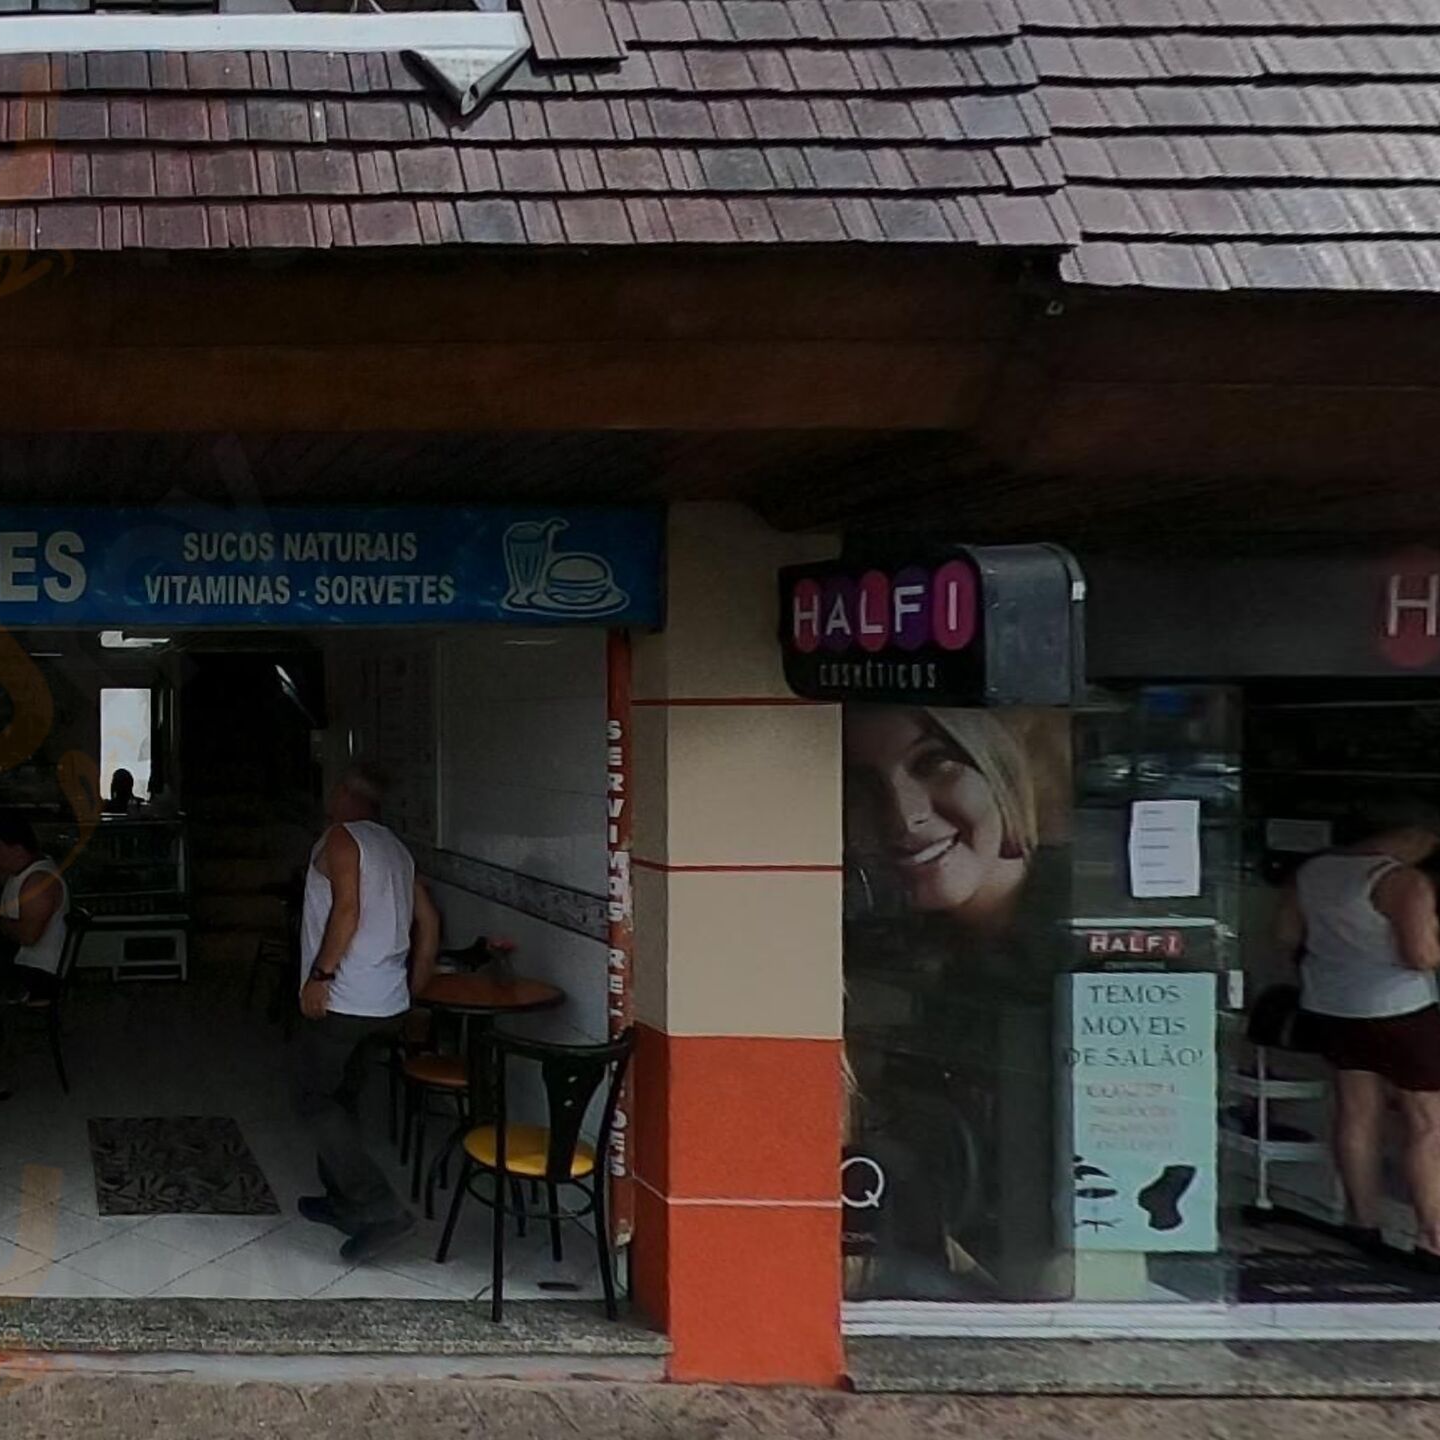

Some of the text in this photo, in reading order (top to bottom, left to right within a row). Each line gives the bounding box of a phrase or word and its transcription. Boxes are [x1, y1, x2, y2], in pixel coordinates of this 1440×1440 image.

[182, 533, 418, 562] SUCOS NATURAIS
[144, 574, 291, 606] VITAMINAS
[314, 574, 456, 606] SORVETES
[1087, 984, 1181, 1004] TEMOS
[1066, 1047, 1098, 1067] DE
